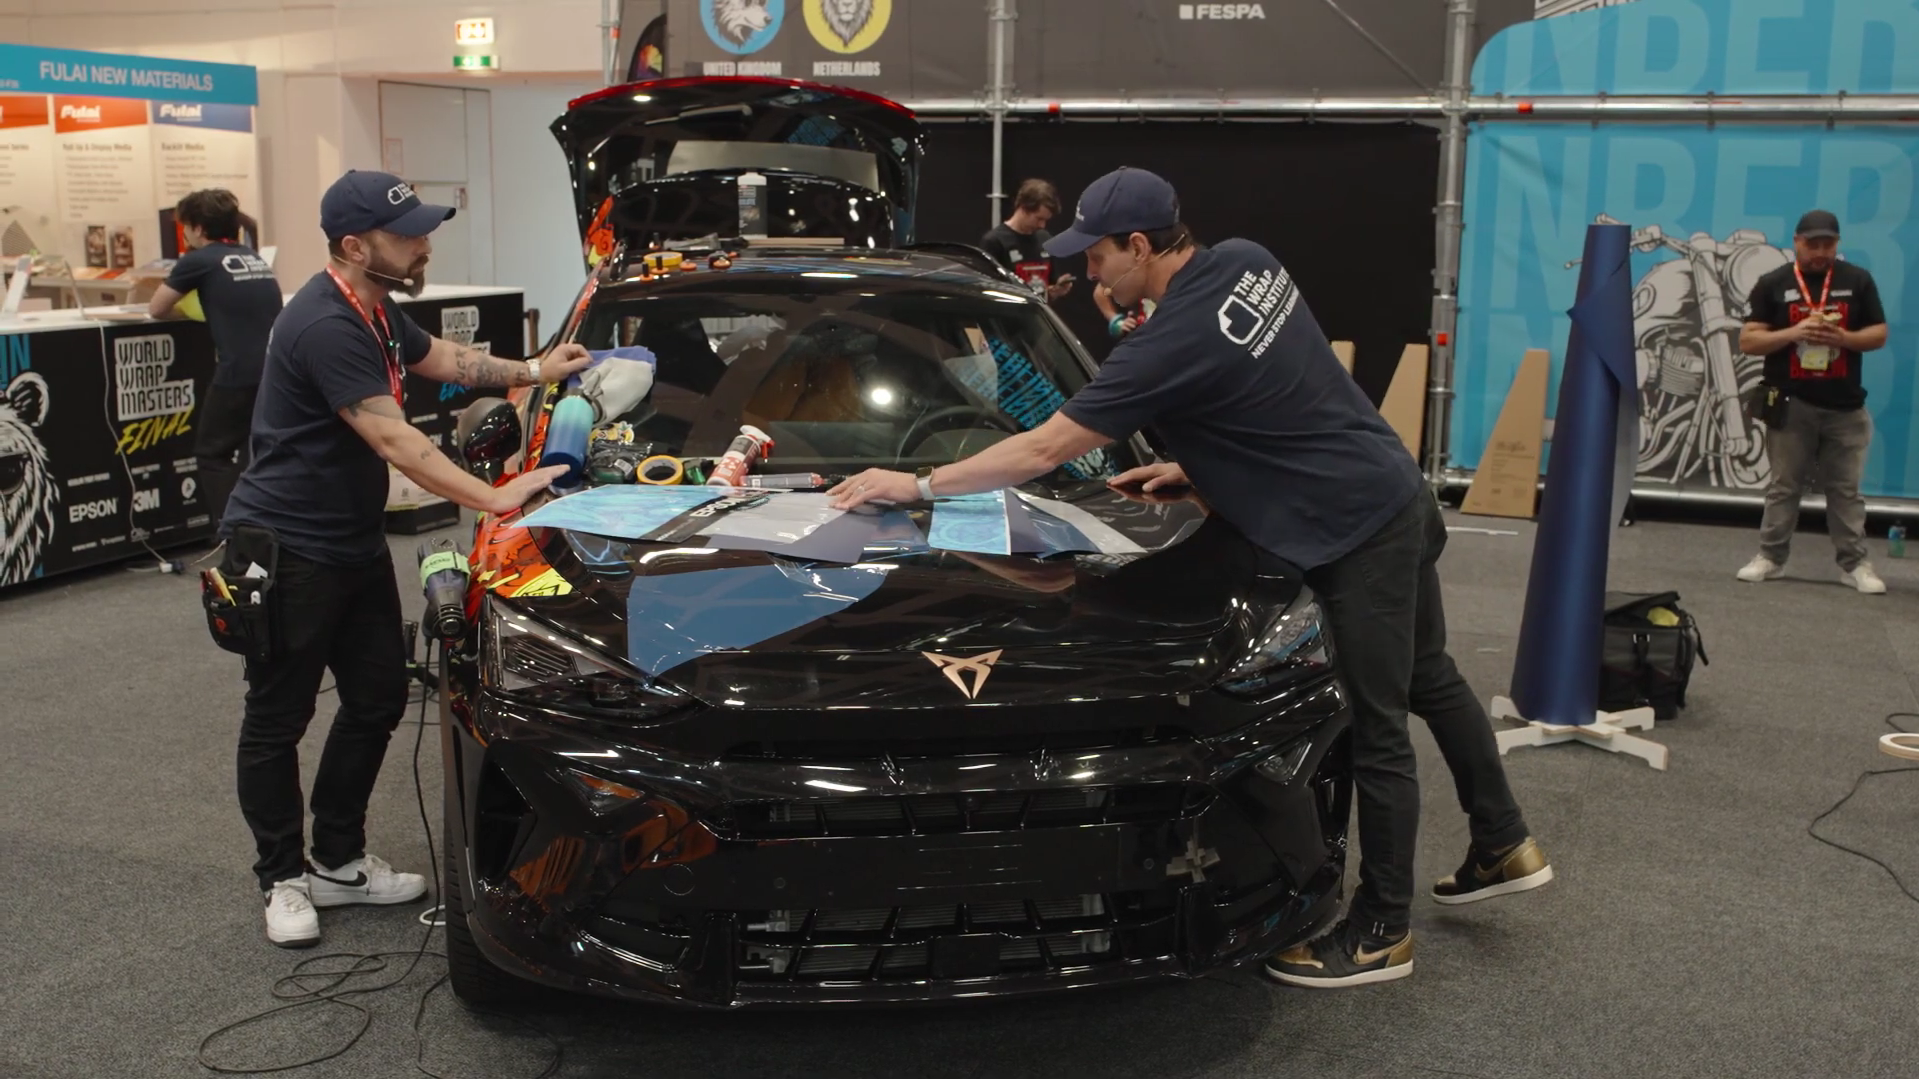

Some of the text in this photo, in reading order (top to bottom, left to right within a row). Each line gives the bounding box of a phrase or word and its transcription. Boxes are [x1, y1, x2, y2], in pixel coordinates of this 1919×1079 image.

[1196, 3, 1266, 20] FESPA
[40, 60, 213, 92] FULAI NEW MATERIALS
[703, 61, 736, 76] UNITED
[812, 61, 881, 77] NETHERLANDS
[60, 105, 101, 119] Fulai
[160, 103, 202, 119] Fulai
[1233, 270, 1257, 296] THE
[1246, 269, 1273, 305] WRAP
[1251, 330, 1276, 359] NEVER
[1271, 312, 1287, 333] STOP
[119, 340, 172, 366] WORLD
[119, 364, 163, 390] WRAP
[121, 384, 191, 415] MASTERS
[115, 408, 193, 455] FINAL
[69, 498, 117, 523] EPSON
[134, 488, 160, 512] 3M
